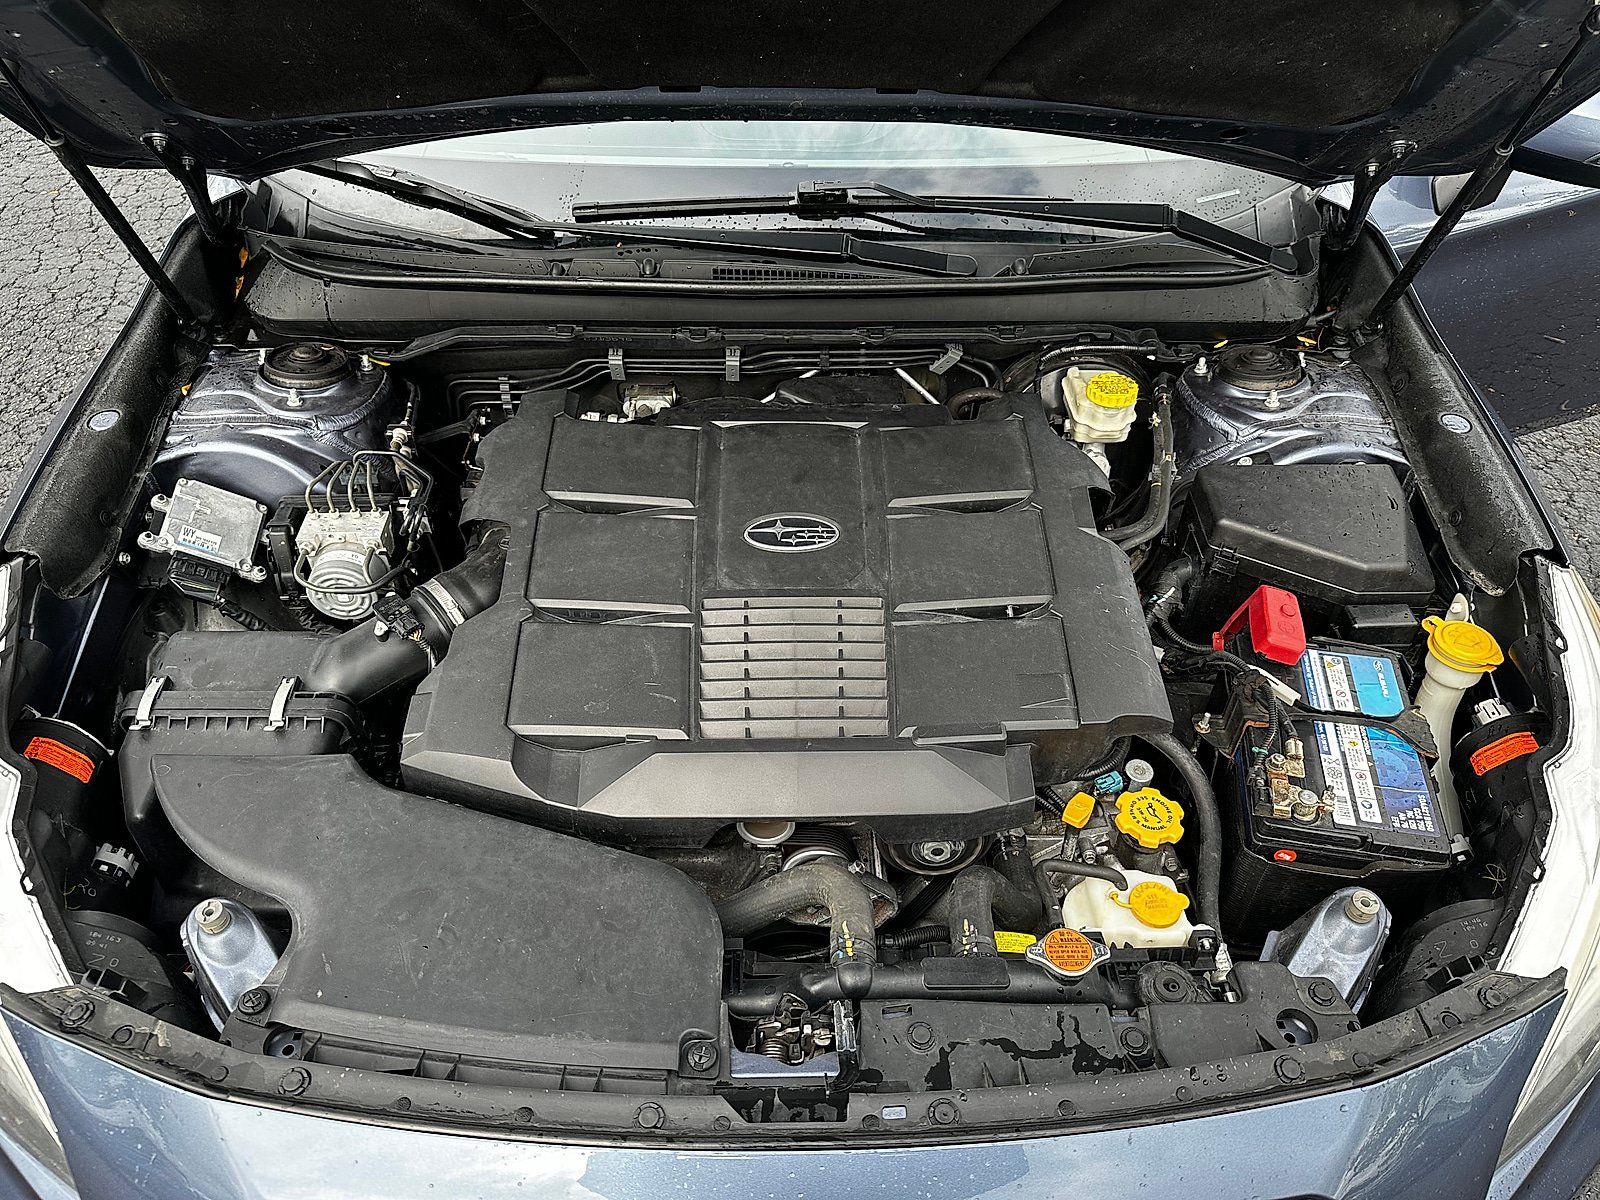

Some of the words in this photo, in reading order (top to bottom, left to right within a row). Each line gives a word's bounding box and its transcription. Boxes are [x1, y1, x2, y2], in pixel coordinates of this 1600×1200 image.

[1152, 797, 1173, 814] ENGINE
[1166, 815, 1174, 824] OIL
[1141, 823, 1167, 831] MANUAL
